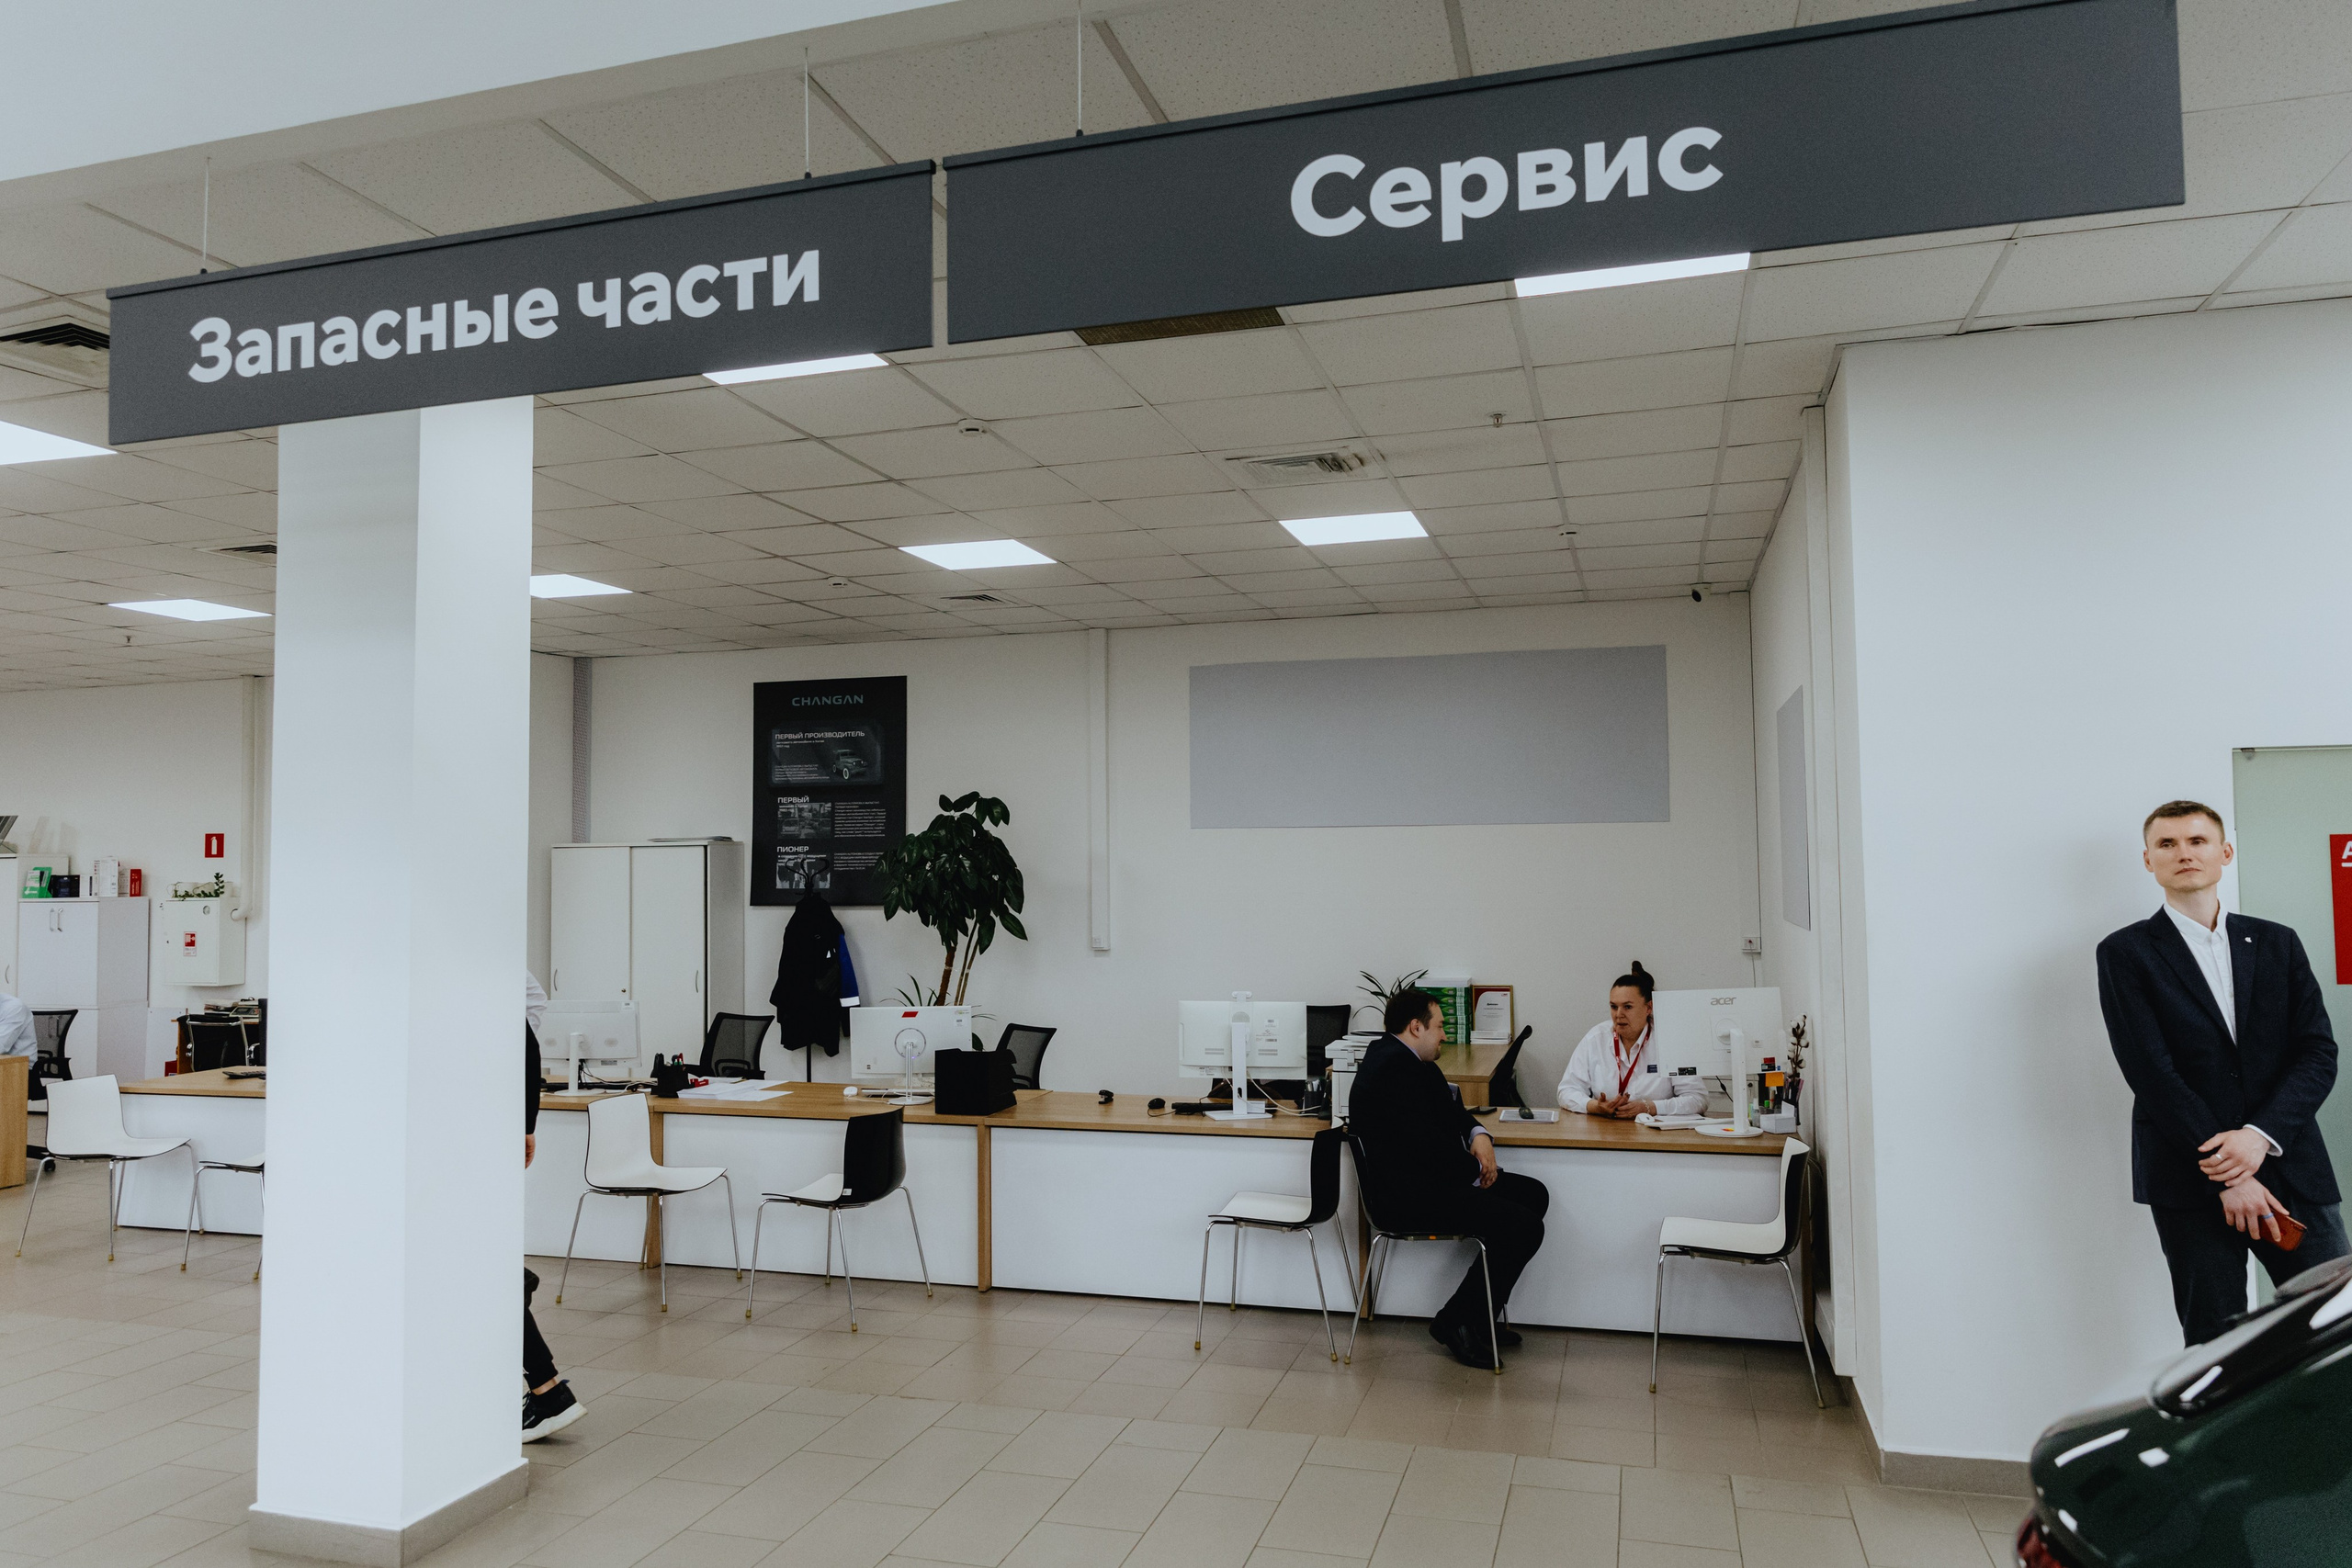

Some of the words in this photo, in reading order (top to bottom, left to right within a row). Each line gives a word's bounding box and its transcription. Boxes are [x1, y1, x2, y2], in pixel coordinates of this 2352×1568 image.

[1290, 126, 1724, 243] Сервис
[187, 287, 560, 384] Запасные
[577, 249, 820, 329] части
[791, 694, 864, 706] CHANGAN
[804, 730, 865, 739] ПРОИЗВОДИТЕЛЬ
[777, 795, 809, 804] ПЕРВЫЙ
[1710, 997, 1736, 1006] acer
